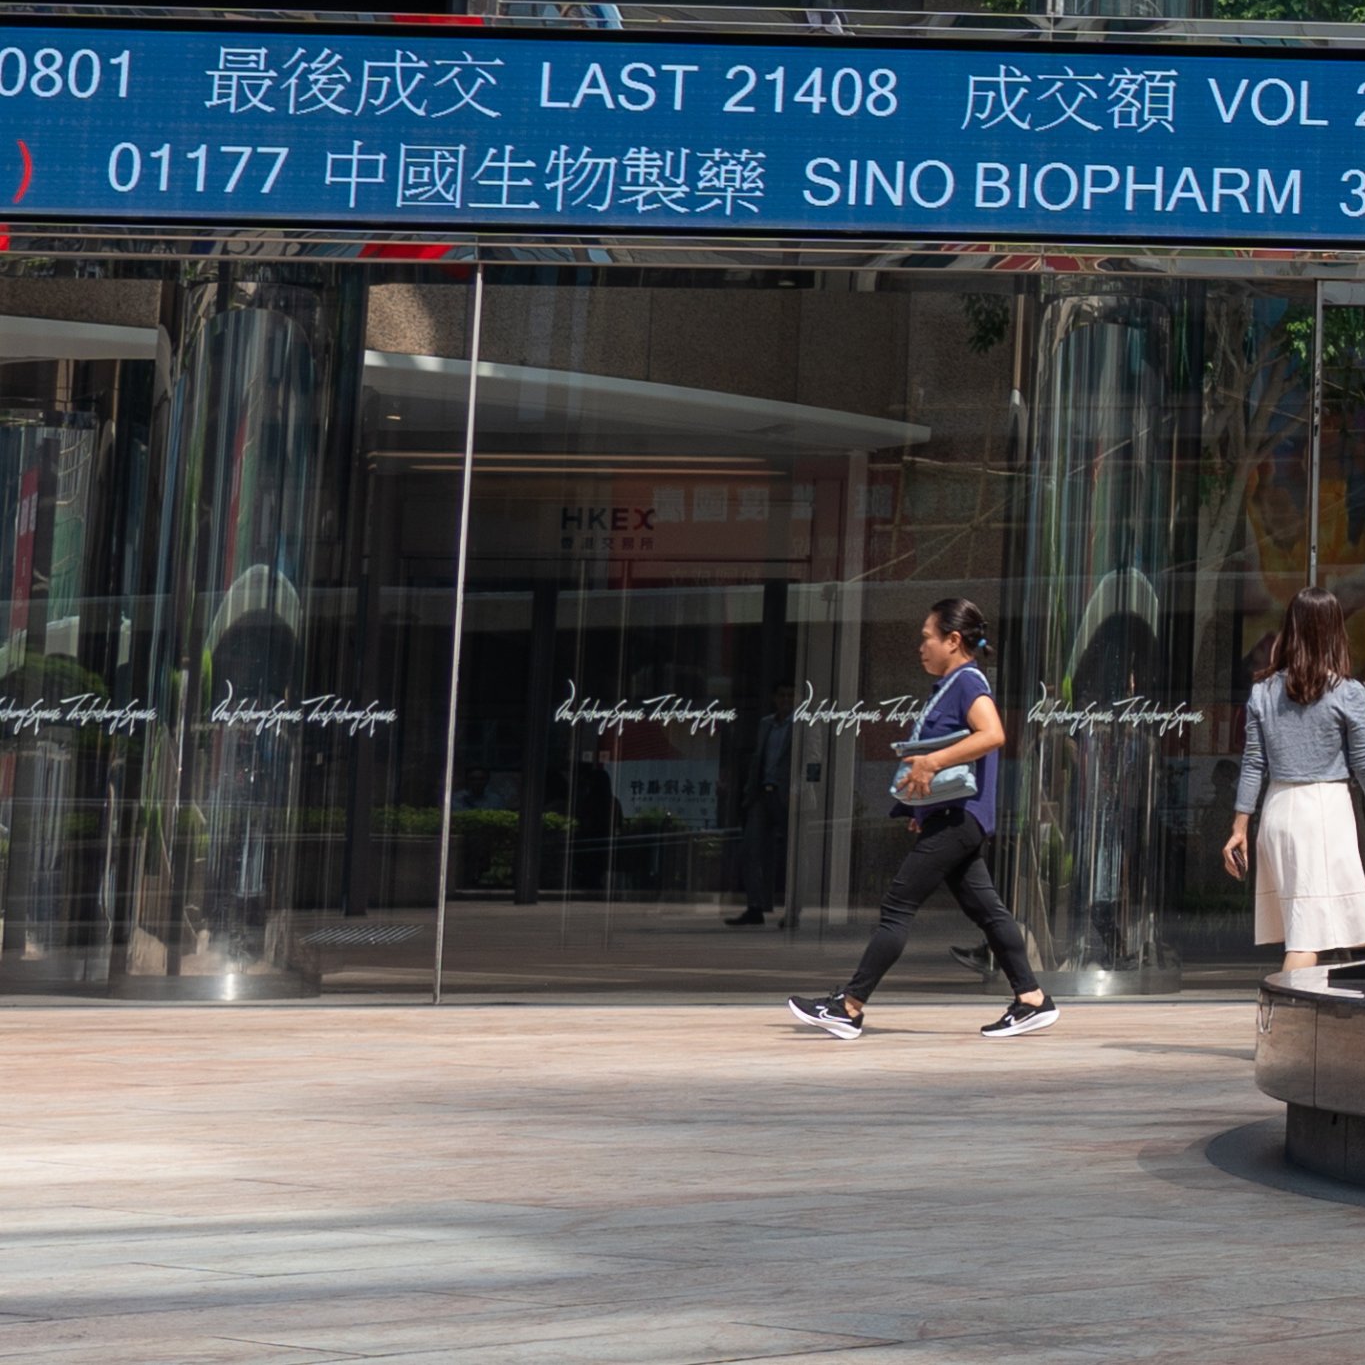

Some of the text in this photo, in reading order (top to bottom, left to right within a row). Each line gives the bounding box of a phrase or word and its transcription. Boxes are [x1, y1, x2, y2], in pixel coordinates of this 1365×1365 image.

[204, 46, 504, 119] 最後成交
[540, 62, 698, 112] LAST
[722, 64, 898, 118] 21408
[961, 63, 1179, 133] 成交額
[1208, 77, 1329, 127] VOL
[107, 142, 290, 194] 01177
[324, 141, 767, 216] 中國生物製藥
[803, 157, 954, 209] SINO
[974, 162, 1301, 215] BIOPHARM
[561, 506, 655, 531] HKEX
